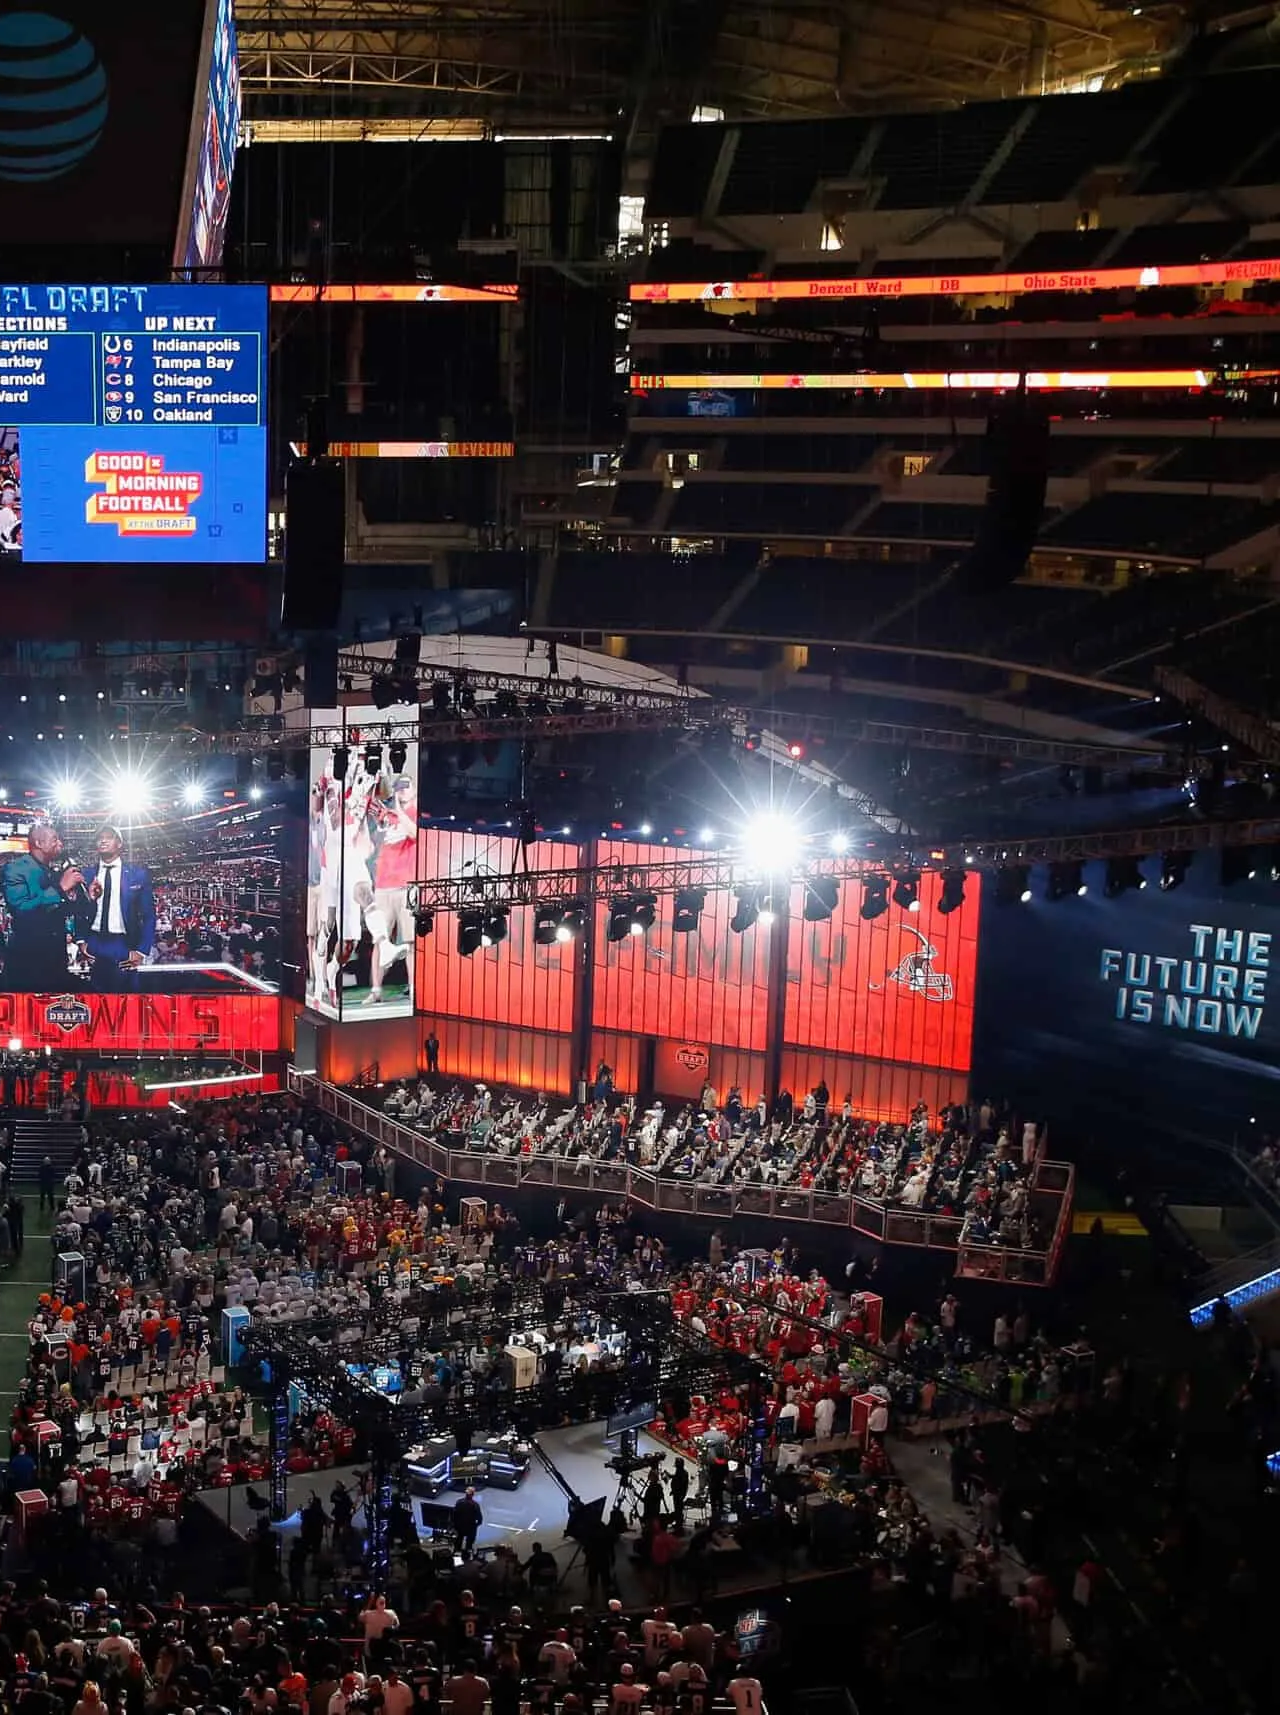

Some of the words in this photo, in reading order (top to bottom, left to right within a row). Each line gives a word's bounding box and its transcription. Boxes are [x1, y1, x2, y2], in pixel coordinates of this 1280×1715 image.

[809, 282, 857, 295] Denzel
[865, 281, 902, 293] Ward
[939, 279, 960, 291] DB
[1023, 275, 1056, 288] Ohio
[1060, 275, 1097, 287] State
[46, 286, 148, 313] DRAFT
[144, 316, 169, 332] UP
[173, 316, 216, 332] NEXT
[123, 339, 133, 351] 6
[152, 338, 241, 354] Indianapolis
[124, 356, 133, 369] 7
[152, 356, 201, 371] Tampa
[206, 356, 234, 371] Bay
[124, 374, 134, 386] 8
[152, 373, 213, 389] Chicago
[124, 392, 135, 404] 9
[153, 392, 182, 404] San
[186, 391, 258, 404] Francisco
[125, 409, 143, 422] 10
[153, 408, 213, 422] Oakland
[97, 455, 143, 470] GOOD
[119, 475, 199, 491] MORNING
[98, 496, 185, 512] FOOTBALL
[156, 518, 192, 529] DRAFT
[1189, 923, 1273, 967] THE
[1100, 948, 1268, 1004] FUTURE
[49, 1012, 87, 1021] DRAFT
[1116, 986, 1154, 1023] IS
[1163, 993, 1264, 1040] NOW
[377, 1275, 389, 1287] 15
[375, 1375, 388, 1387] 59
[71, 1611, 86, 1629] 13
[652, 1632, 669, 1648] 12
[745, 1690, 753, 1708] 1
